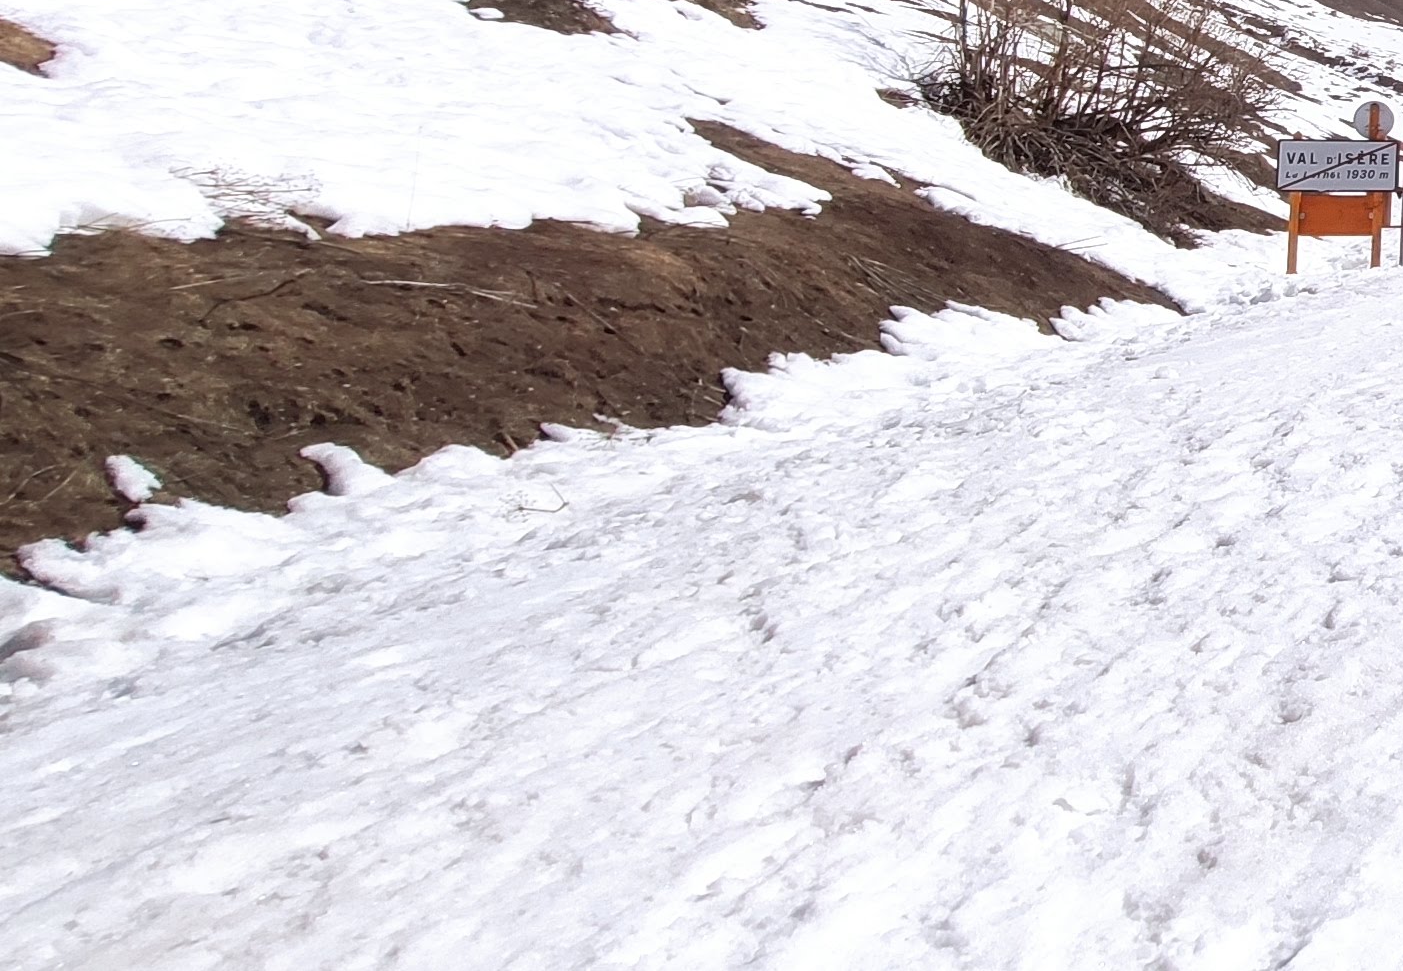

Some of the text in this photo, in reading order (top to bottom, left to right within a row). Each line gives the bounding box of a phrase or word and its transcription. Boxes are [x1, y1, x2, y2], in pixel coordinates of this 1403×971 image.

[1286, 152, 1318, 165] VAL
[1346, 169, 1376, 180] 1930
[1378, 171, 1389, 179] m
